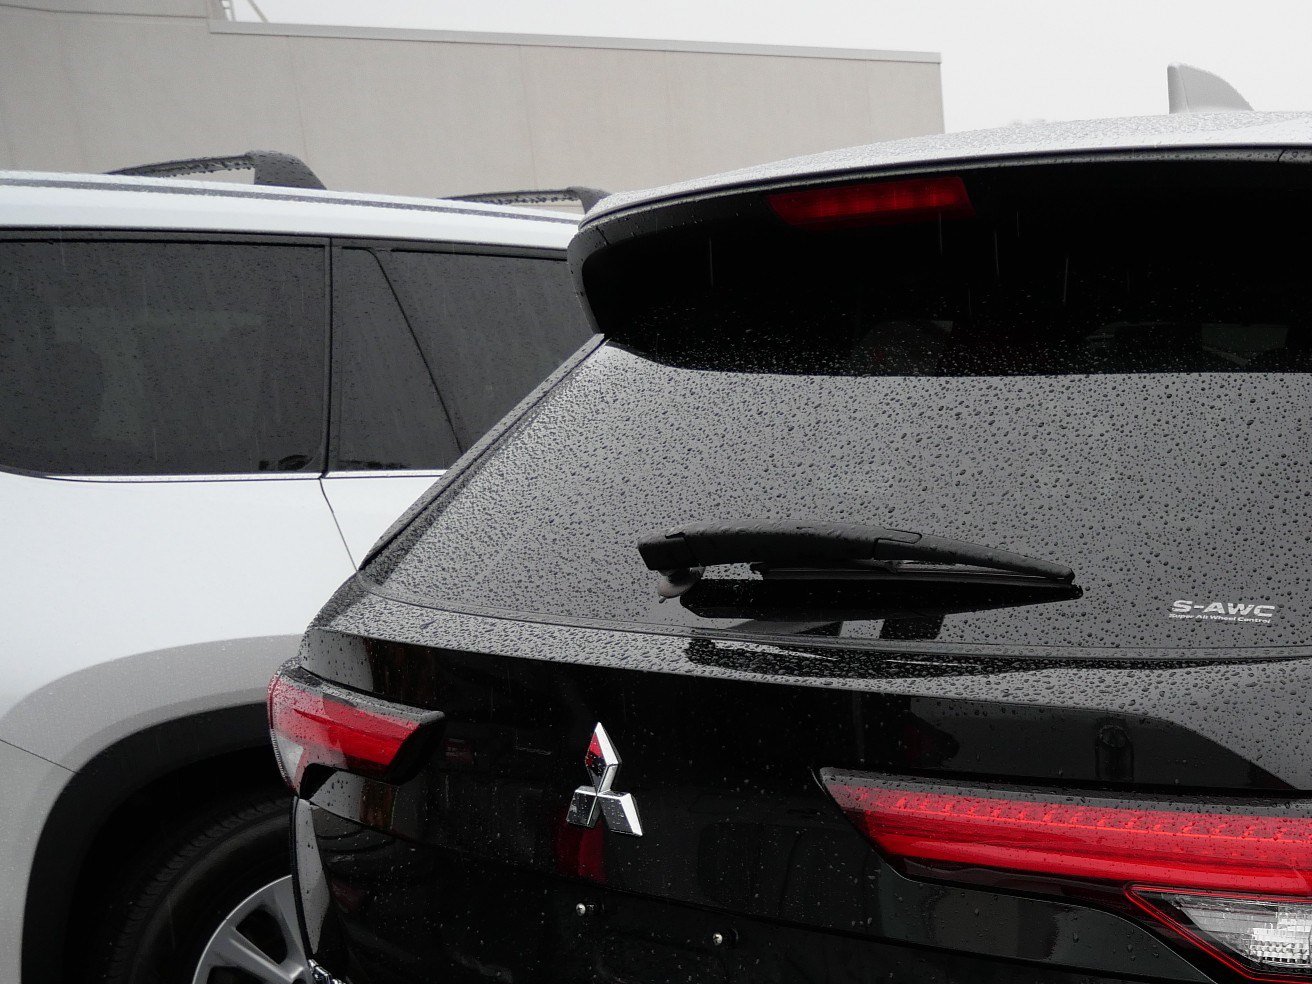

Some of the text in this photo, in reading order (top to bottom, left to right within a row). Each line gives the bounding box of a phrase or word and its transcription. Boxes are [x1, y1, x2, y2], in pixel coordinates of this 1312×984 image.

[1172, 600, 1275, 617] S-AWC
[1168, 612, 1195, 620] Super
[1237, 616, 1271, 624] Control
